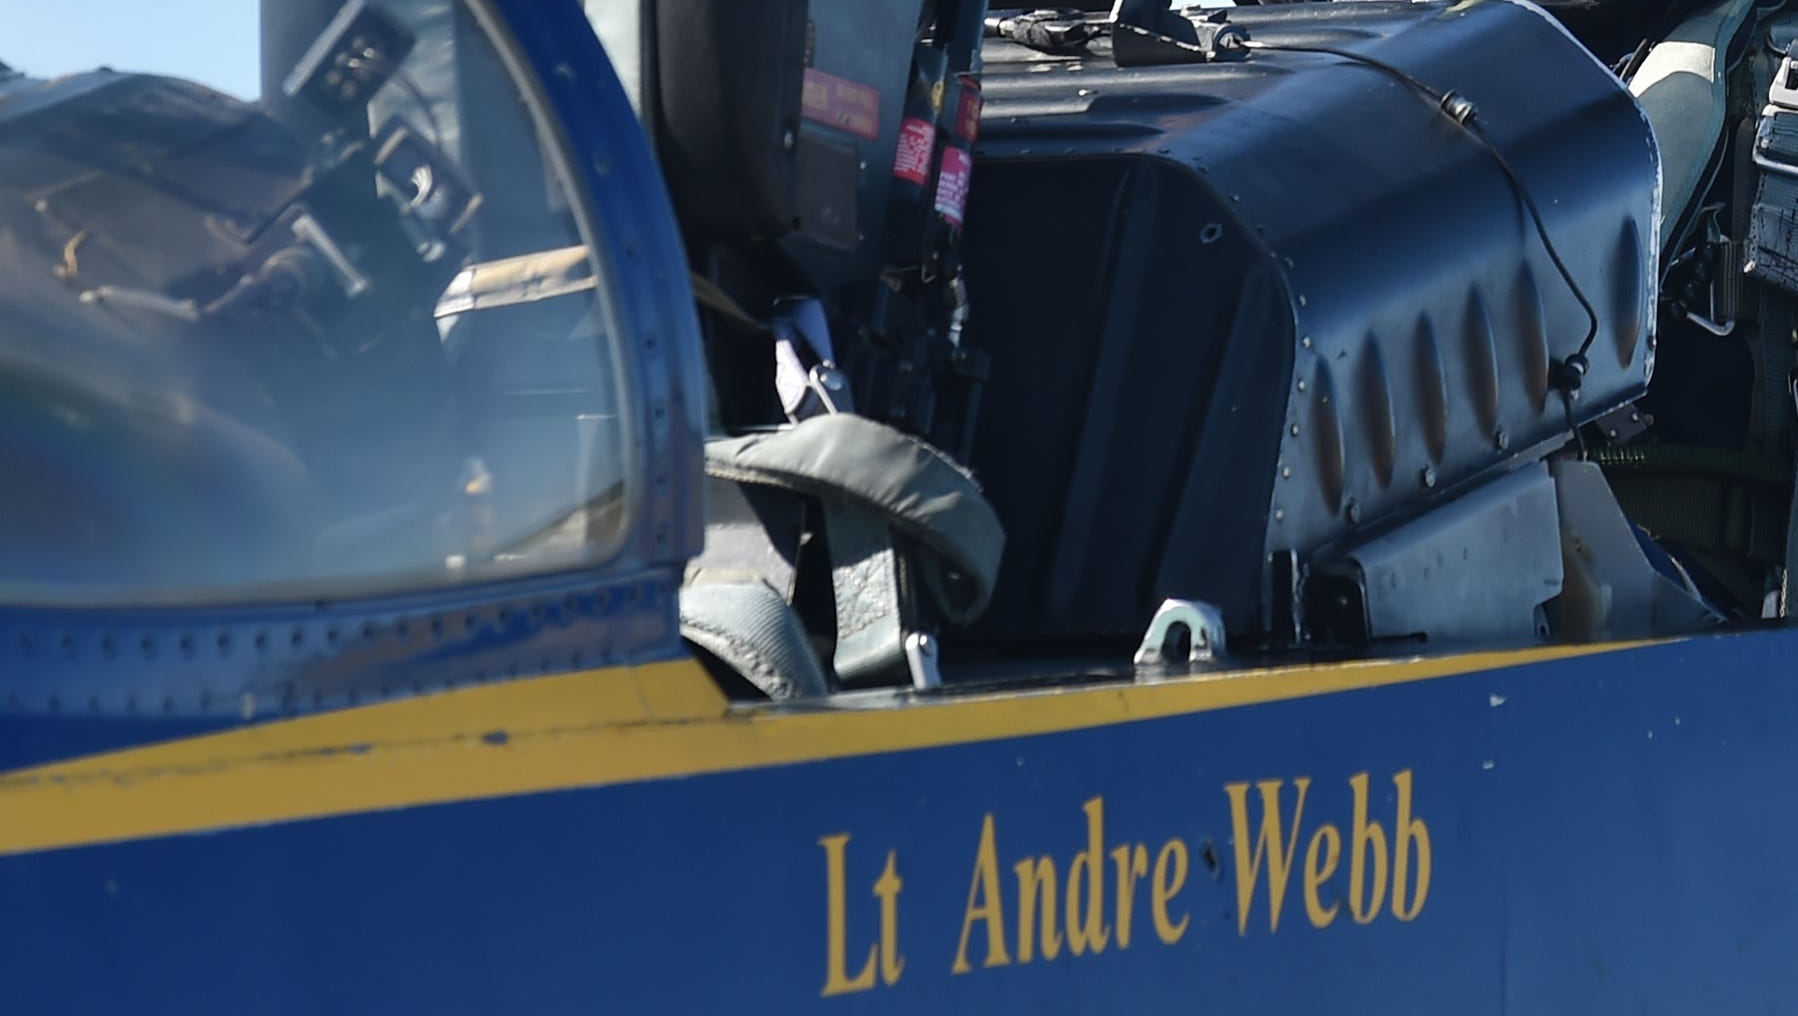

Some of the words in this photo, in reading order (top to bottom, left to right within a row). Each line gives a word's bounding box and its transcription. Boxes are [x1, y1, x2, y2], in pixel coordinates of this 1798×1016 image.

[819, 834, 905, 996] Lt
[952, 796, 1189, 974] Andre
[1225, 769, 1432, 935] Webb
